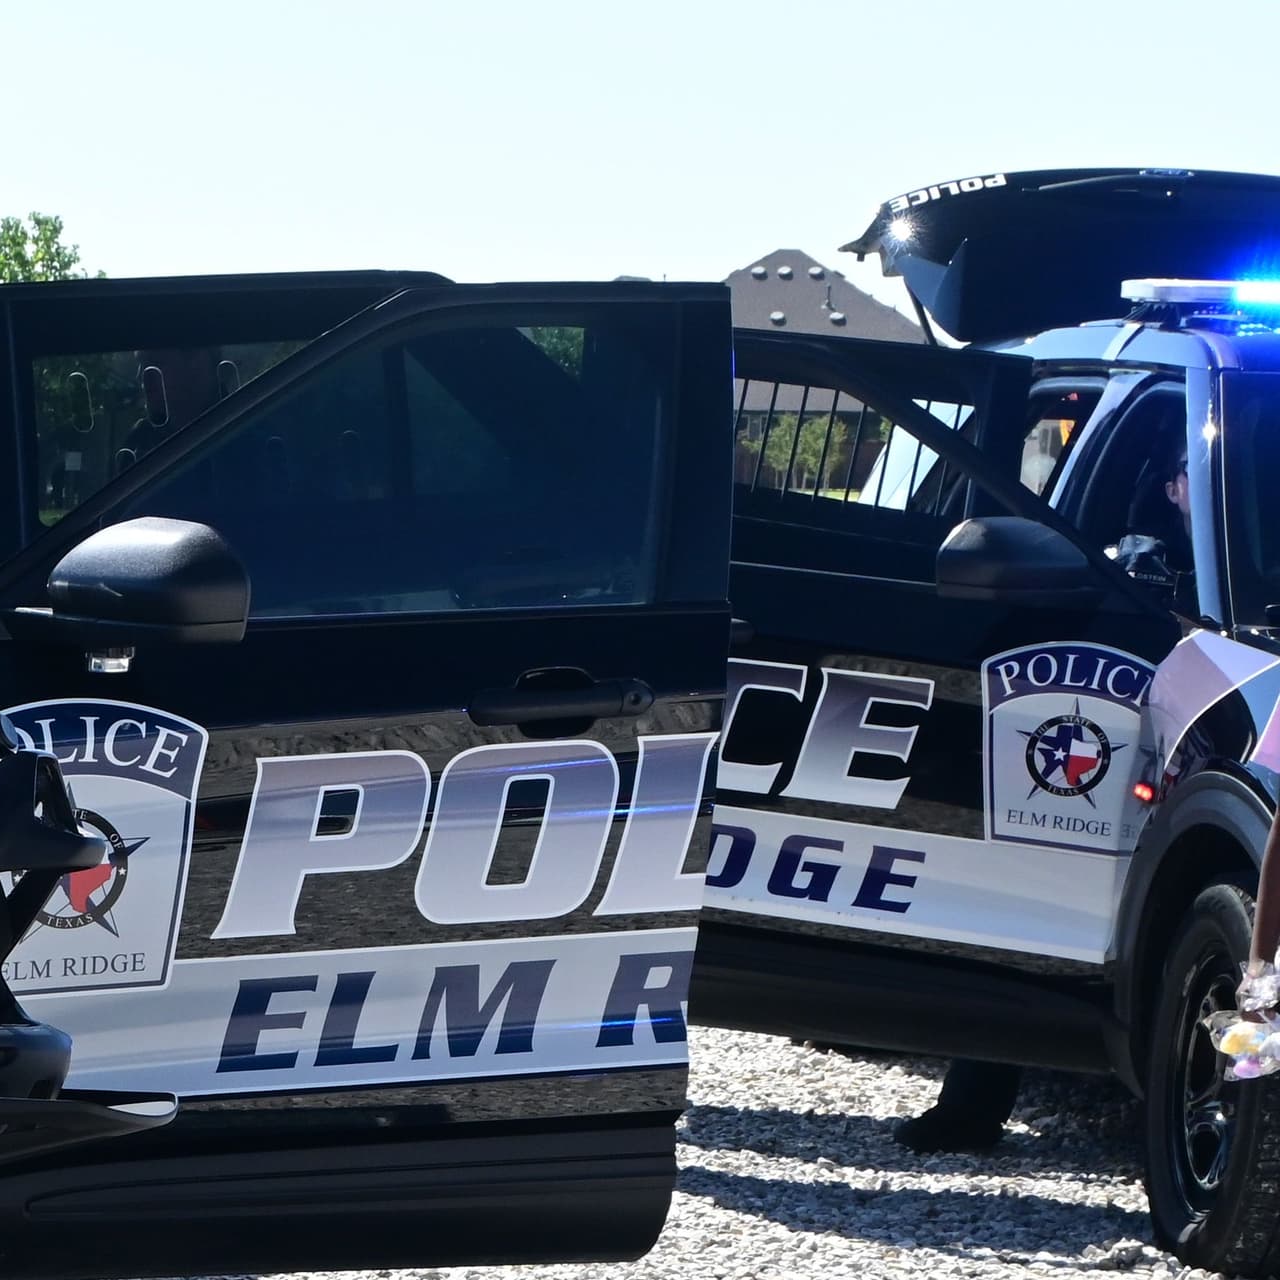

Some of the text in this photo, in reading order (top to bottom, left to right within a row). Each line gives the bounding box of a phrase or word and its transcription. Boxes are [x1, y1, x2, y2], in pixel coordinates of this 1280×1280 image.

[888, 173, 1007, 213] POLICE
[15, 716, 189, 778] LICE
[1007, 808, 1112, 837] ELM RIDGE
[46, 912, 94, 929] TEXAS
[62, 952, 146, 978] RIDGE
[216, 958, 557, 1074] ELM
